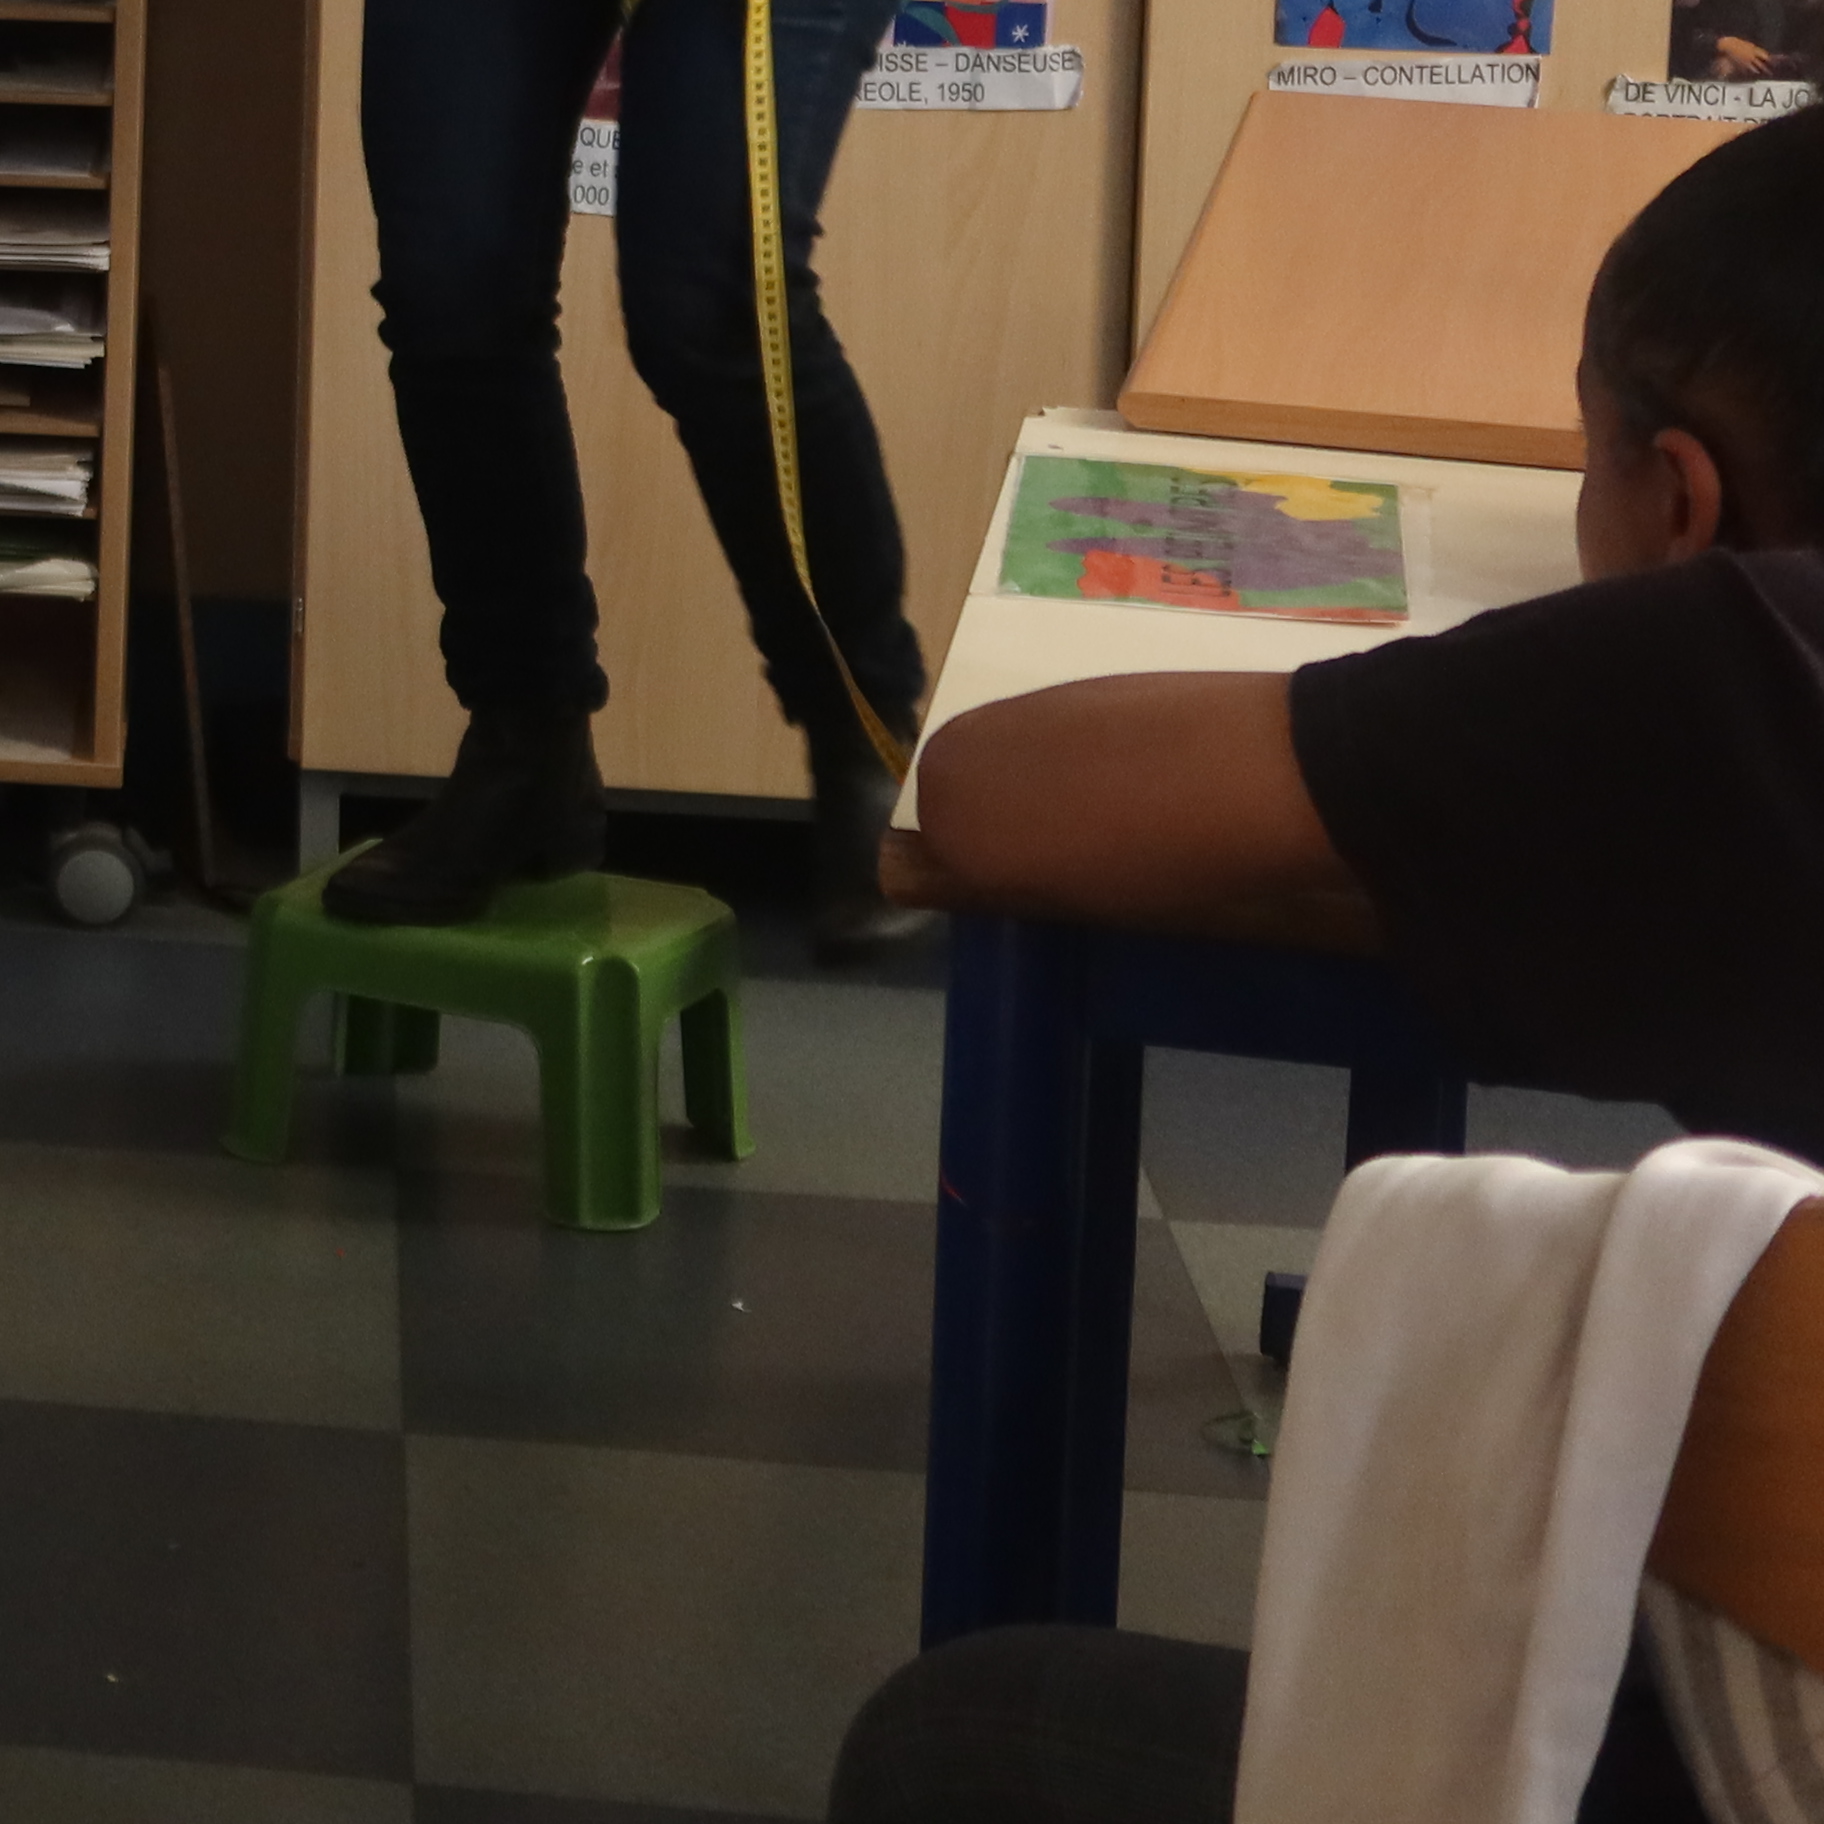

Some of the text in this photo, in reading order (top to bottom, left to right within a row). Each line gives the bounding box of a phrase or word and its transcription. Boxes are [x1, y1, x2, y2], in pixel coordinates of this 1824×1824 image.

[954, 51, 1075, 74] DANSEUSE
[1276, 64, 1337, 88] MIRO
[1363, 63, 1540, 86] CONTELLATION
[937, 82, 985, 103] 1950
[1624, 83, 1656, 103] DE
[1664, 84, 1727, 106] VINCI
[1749, 87, 1777, 108] LA
